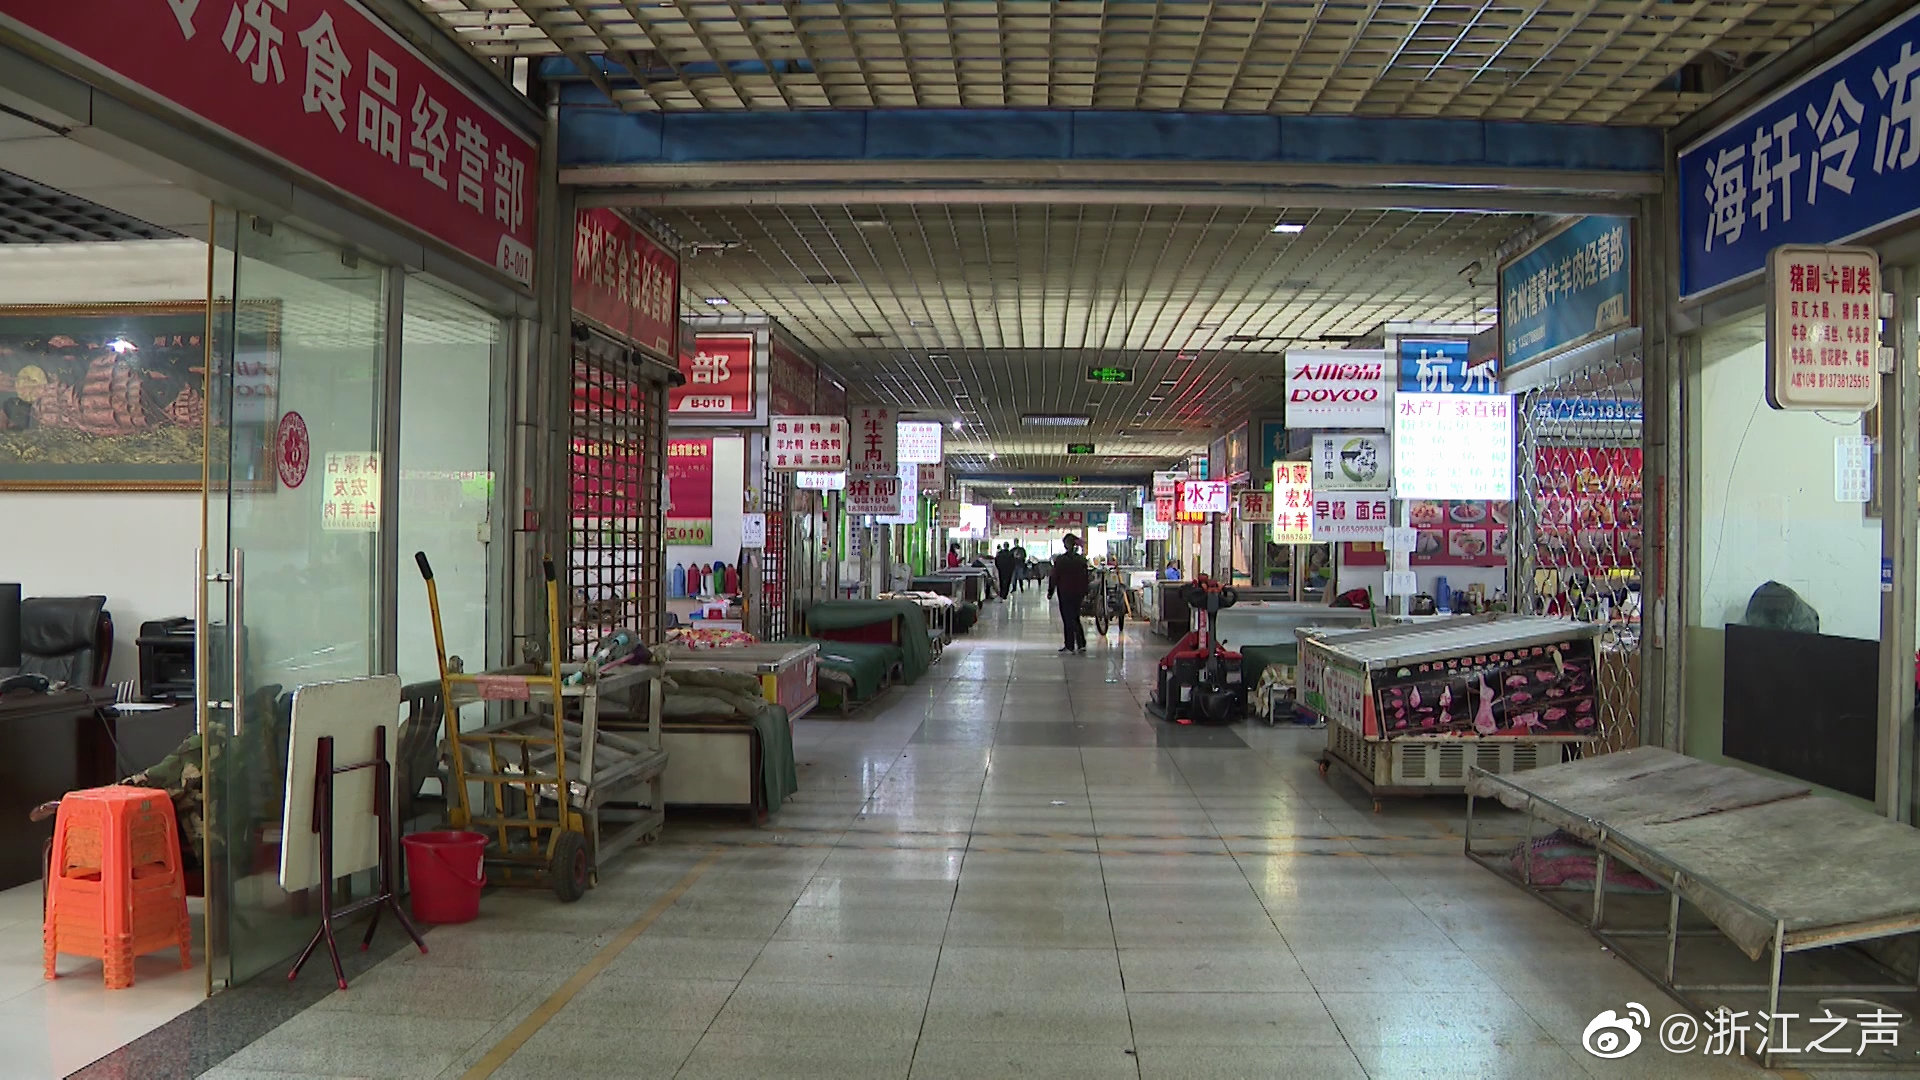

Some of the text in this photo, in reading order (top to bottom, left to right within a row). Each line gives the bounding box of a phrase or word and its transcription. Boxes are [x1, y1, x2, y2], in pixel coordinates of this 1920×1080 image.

[166, 0, 526, 233] 冻食品经营部
[1705, 42, 1920, 252] 海轩冷冻
[504, 244, 528, 279] B-001
[691, 351, 730, 384] 部
[691, 399, 725, 409] B-010
[1290, 388, 1378, 402] DOYOO
[1400, 399, 1507, 418] 水产厂家直销
[863, 420, 883, 461] 牛羊肉
[848, 479, 896, 496] 猪副
[1187, 483, 1225, 504] 水产
[1356, 501, 1386, 520] 面点
